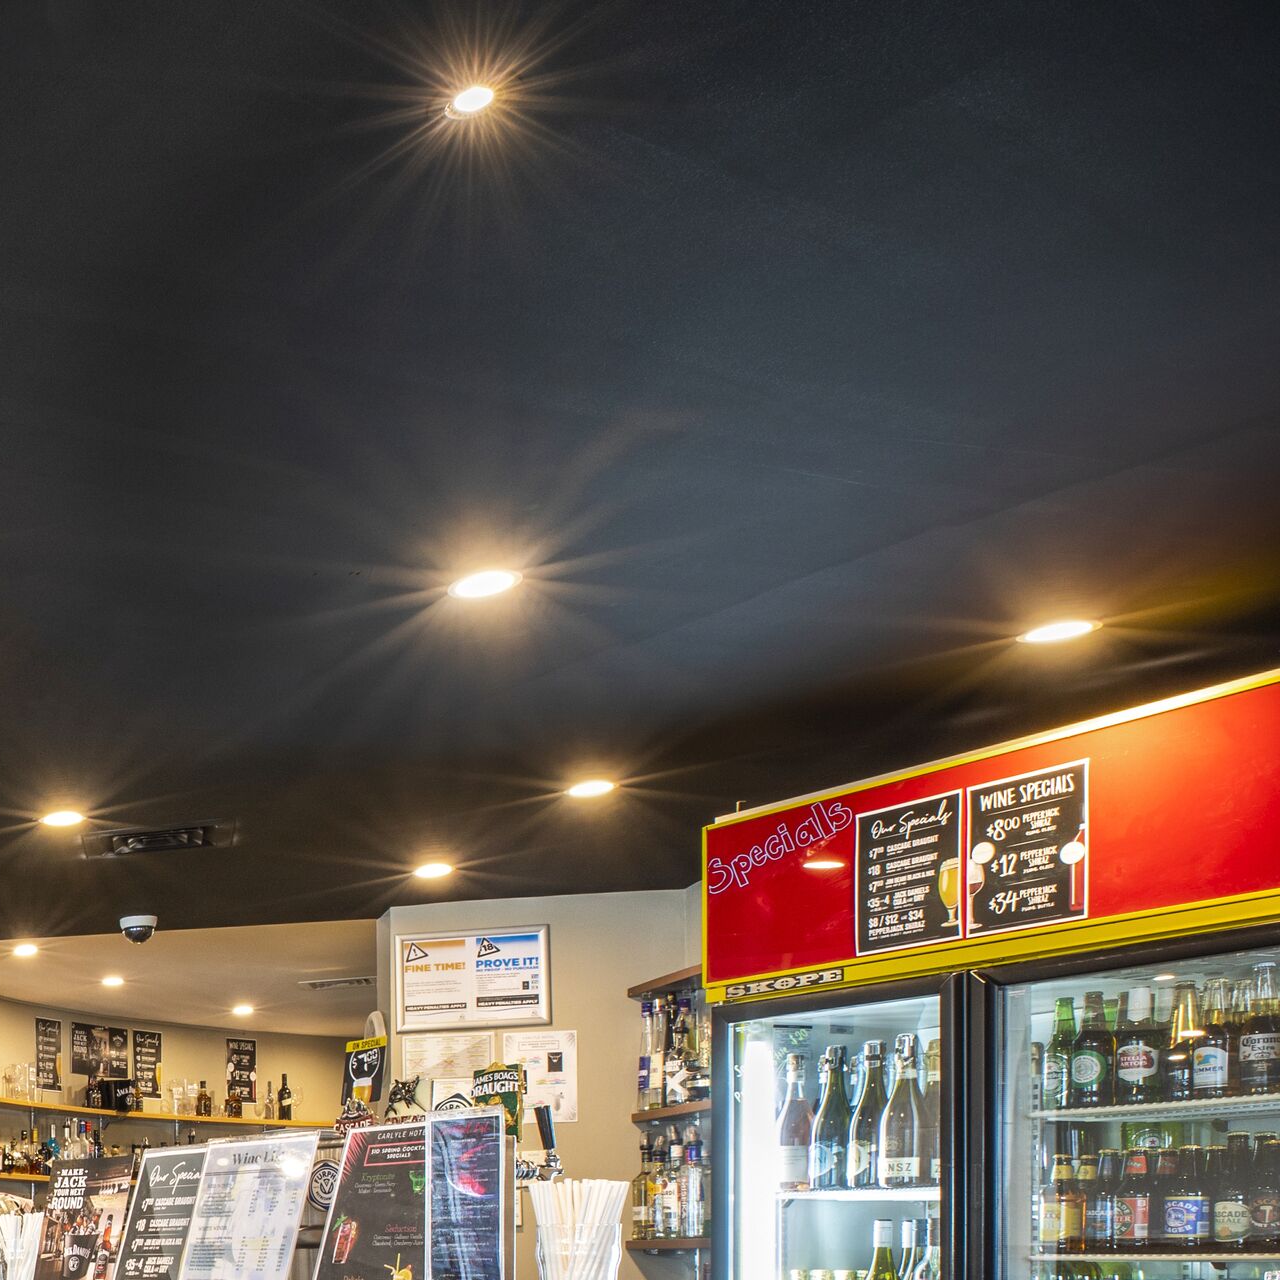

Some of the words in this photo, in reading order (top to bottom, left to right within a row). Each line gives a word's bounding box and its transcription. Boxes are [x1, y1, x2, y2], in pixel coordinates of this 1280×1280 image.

[980, 787, 1017, 811] WINE
[1019, 773, 1075, 803] SPECIALS
[871, 819, 896, 839] Our
[899, 799, 952, 839] Specials
[1022, 807, 1060, 823] PEPPERJACK
[708, 802, 853, 894] Specials
[886, 840, 912, 853] CASCADE
[912, 834, 939, 847] DRAUGHT
[1020, 845, 1058, 861] PEPPERJACK
[868, 864, 881, 877] $18
[886, 858, 911, 871] CASCADE
[911, 852, 939, 865] DRAUGHT
[991, 853, 1018, 877] $12
[893, 889, 907, 900] JACK
[1020, 884, 1058, 898] PEPPERJACK
[893, 896, 907, 906] COLA
[989, 891, 1020, 914] $34
[885, 913, 899, 927] $12
[908, 909, 924, 922] $34
[868, 923, 904, 937] PEPPERJACK
[905, 919, 926, 931] SHIRAZ
[482, 943, 494, 952] 18
[405, 963, 431, 973] FINE
[434, 962, 466, 971] TIME!
[476, 958, 521, 969] PROVE
[522, 957, 539, 966] IT!
[726, 970, 843, 998] SKOPE
[352, 1042, 360, 1050] ON
[361, 1039, 381, 1049] SPECIAL
[471, 1081, 519, 1098] DRAUGHT
[333, 1119, 372, 1132] CASCADE
[377, 1131, 406, 1140] CARLYLE
[409, 1129, 426, 1138] HOTE
[386, 1152, 411, 1160] SPECIALS
[60, 1168, 84, 1176] MAKE
[149, 1165, 170, 1188] Our
[169, 1161, 202, 1195] Specia
[54, 1176, 87, 1189] JACK
[53, 1189, 69, 1197] YOUR
[69, 1188, 86, 1196] NEXT
[52, 1197, 84, 1210] ROUND
[154, 1197, 174, 1207] CASCADE
[135, 1218, 147, 1232] $18
[149, 1218, 169, 1227] CASCADE
[169, 1217, 190, 1227] DRAUGHT
[145, 1257, 159, 1265] JACK
[159, 1256, 175, 1265] DANIELS
[144, 1265, 155, 1274] COLA
